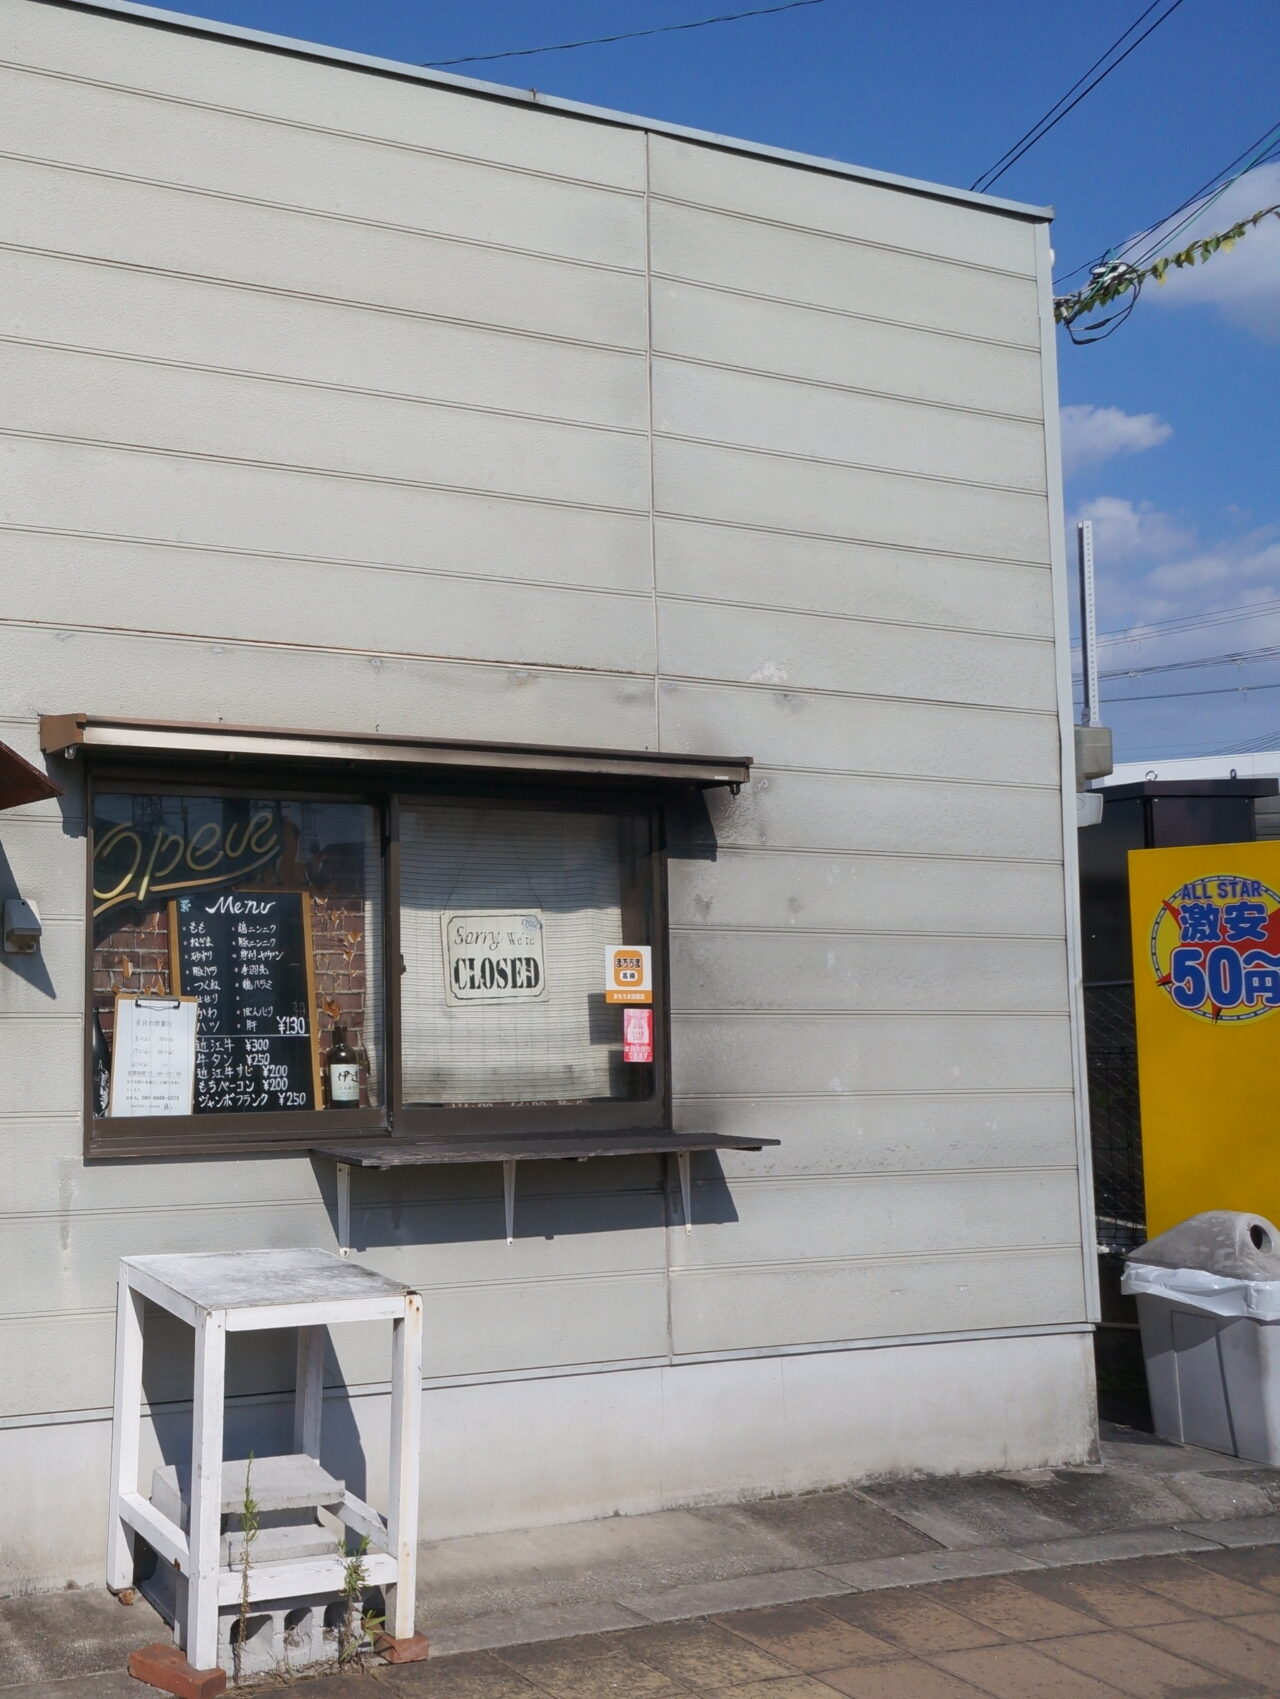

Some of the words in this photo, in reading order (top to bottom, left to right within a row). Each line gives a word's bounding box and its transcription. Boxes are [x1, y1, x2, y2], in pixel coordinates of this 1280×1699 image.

[1181, 883, 1212, 901] ALL
[1217, 880, 1263, 899] STAR
[205, 895, 276, 914] Menu
[188, 920, 206, 934] もも
[1178, 900, 1270, 943] 激安
[189, 935, 214, 948] ねぎま
[454, 926, 501, 951] Sorry
[240, 963, 270, 976] 手羽先
[453, 956, 540, 990] CLOSED
[193, 979, 221, 991] つくね
[197, 1006, 218, 1019] かわ
[196, 1021, 220, 1032] ハツ
[276, 1015, 306, 1034] ¥130
[195, 1038, 235, 1053] 近江牛
[245, 1039, 269, 1052] ¥300
[196, 1053, 234, 1067] 牛タン
[246, 1053, 270, 1067] ¥250
[197, 1063, 253, 1079] 近江牛すじ
[262, 1064, 288, 1078] ¥200
[198, 1080, 255, 1093] もちベーコン
[262, 1078, 289, 1092] ¥200
[198, 1092, 269, 1108] ジャンボフランク
[277, 1092, 307, 1106] ¥250
